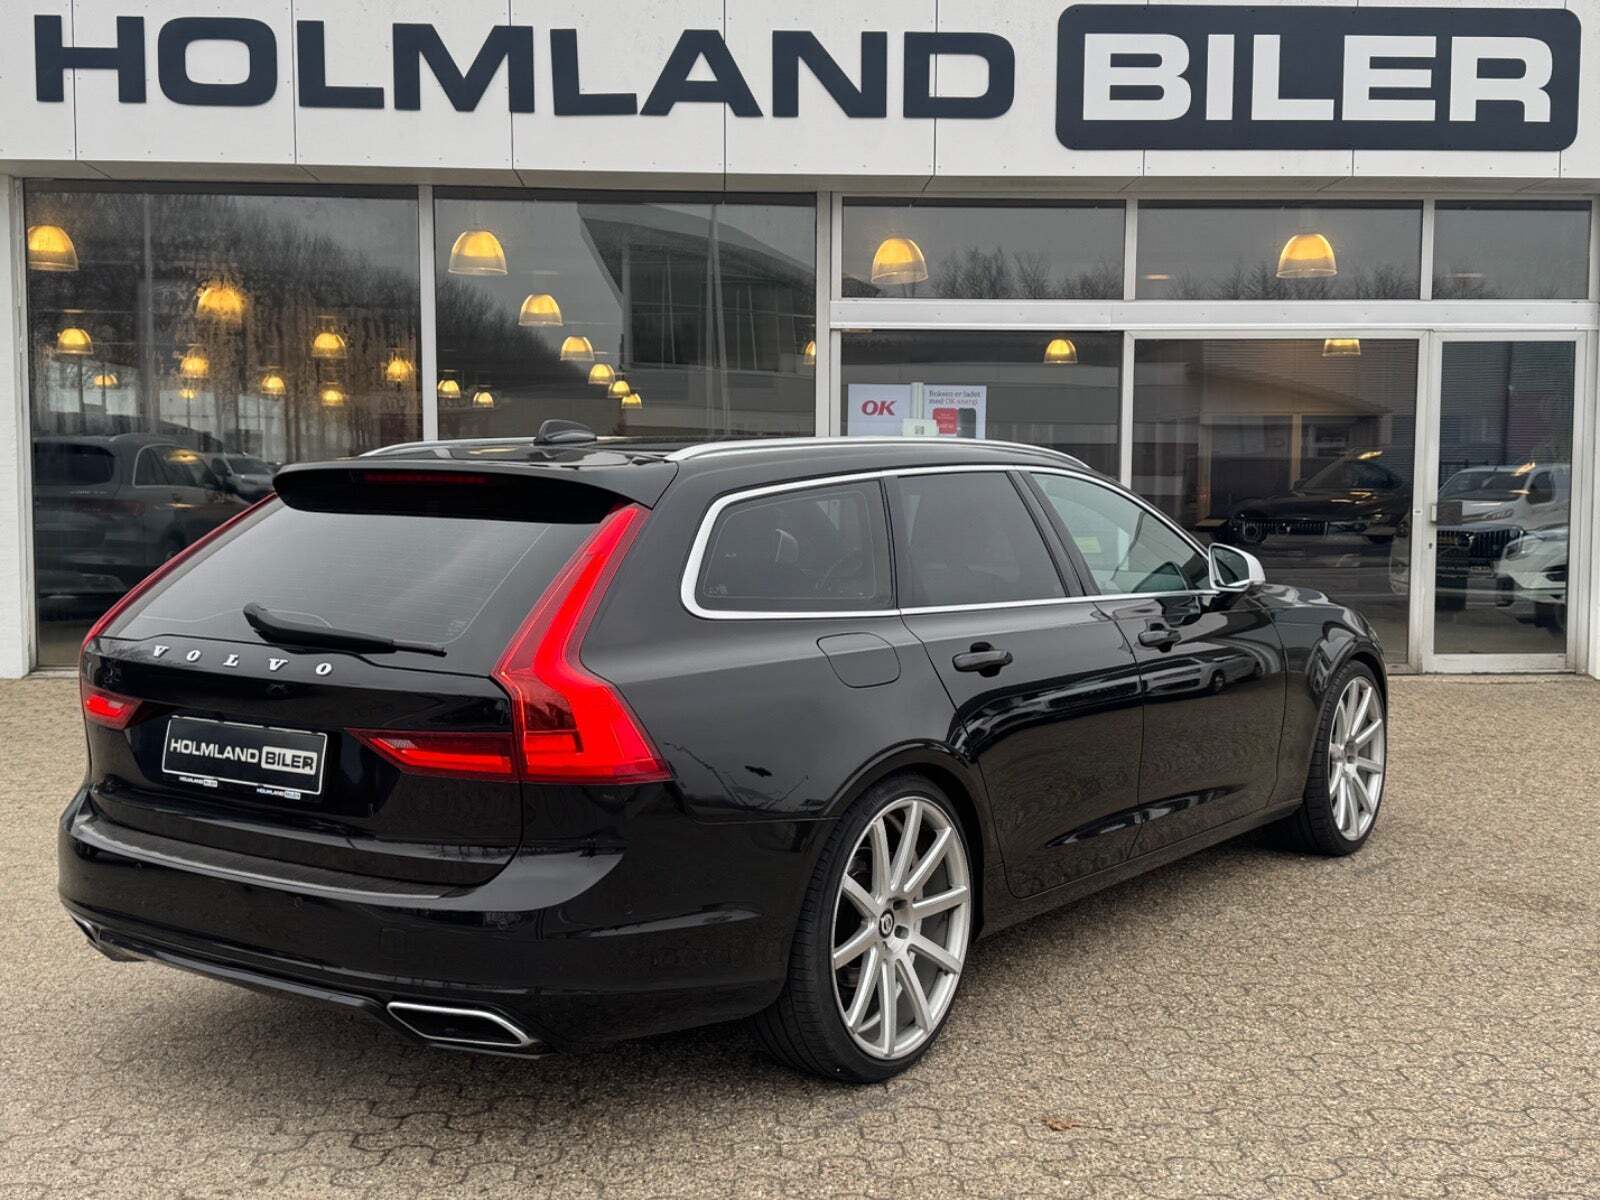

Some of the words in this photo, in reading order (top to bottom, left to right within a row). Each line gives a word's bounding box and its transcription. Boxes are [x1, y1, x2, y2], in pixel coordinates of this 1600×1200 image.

[33, 14, 1015, 119] HOLMLAND
[1082, 32, 1553, 123] BILER
[861, 400, 896, 416] OK
[152, 644, 333, 676] VOLVO
[169, 738, 260, 764] HOLMLAND
[264, 752, 315, 771] BILER
